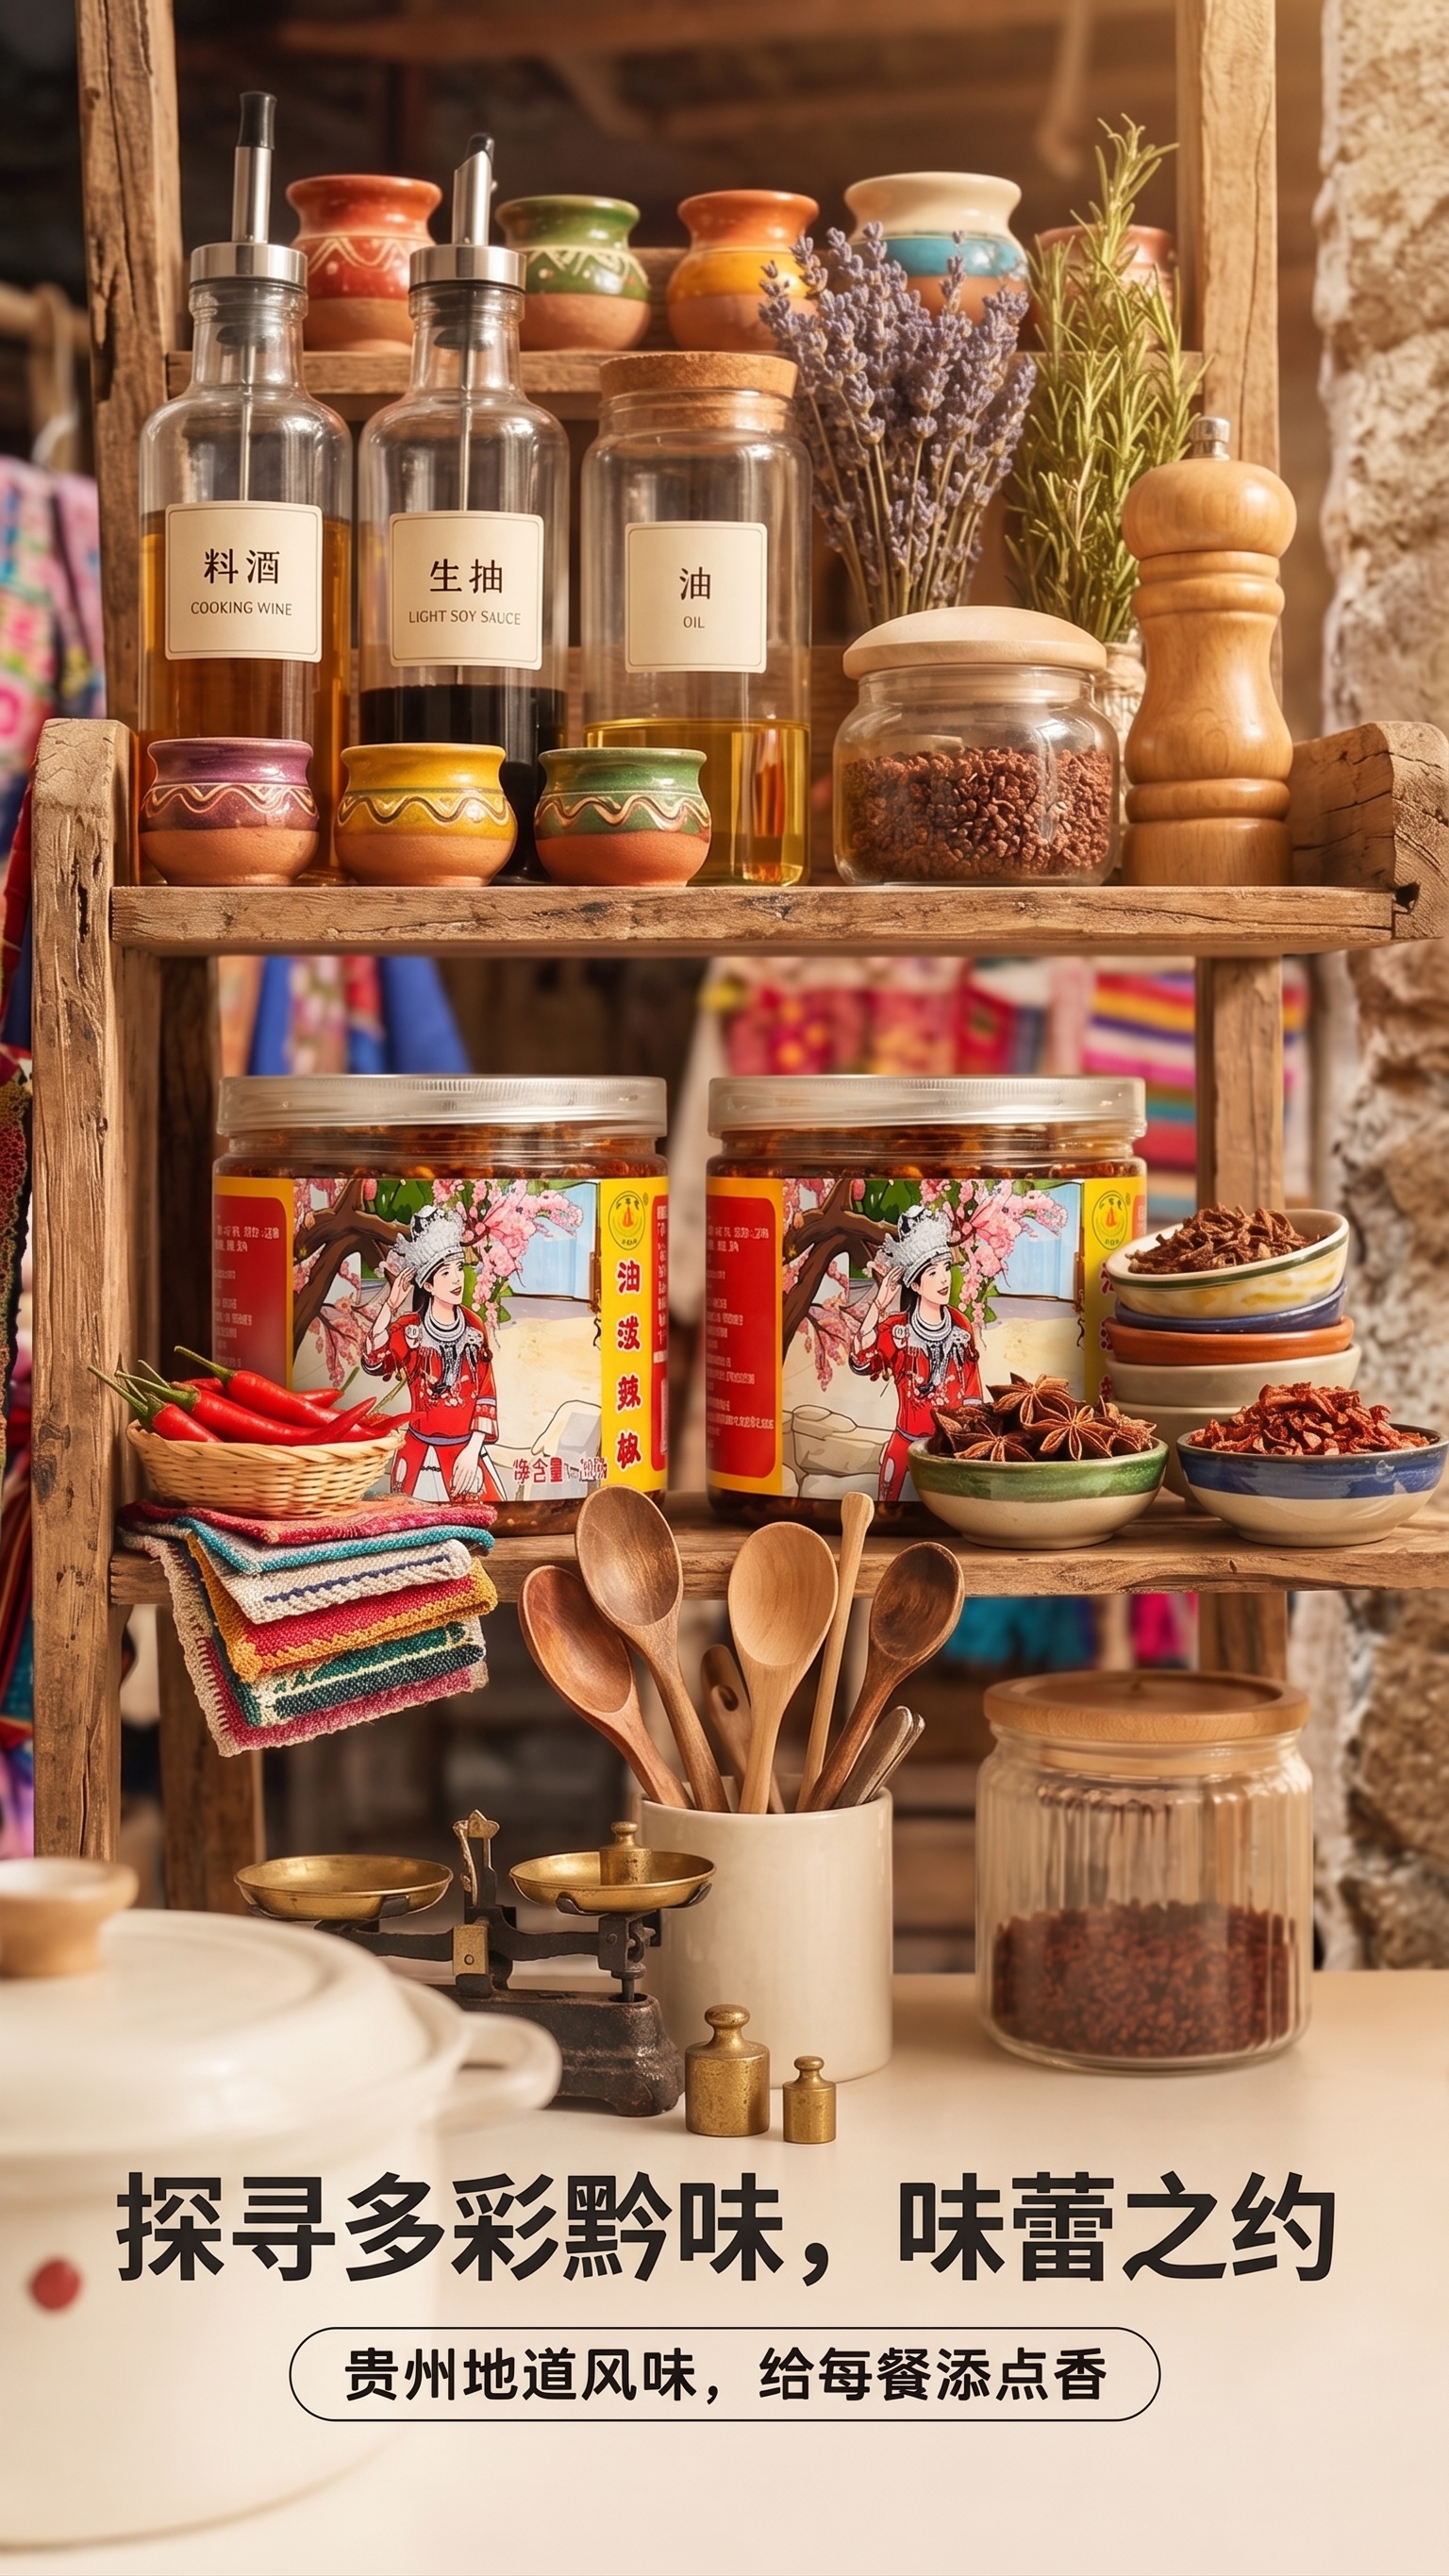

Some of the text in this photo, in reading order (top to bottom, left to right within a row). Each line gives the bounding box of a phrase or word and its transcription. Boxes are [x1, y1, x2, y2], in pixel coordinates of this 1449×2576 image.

[203, 546, 281, 585] 料酒
[429, 558, 503, 594] 生抽
[678, 566, 712, 601] 油
[191, 600, 292, 616] COOKING WINE
[408, 610, 521, 626] LIGHT SOY SAUCE
[682, 615, 706, 629] OIL
